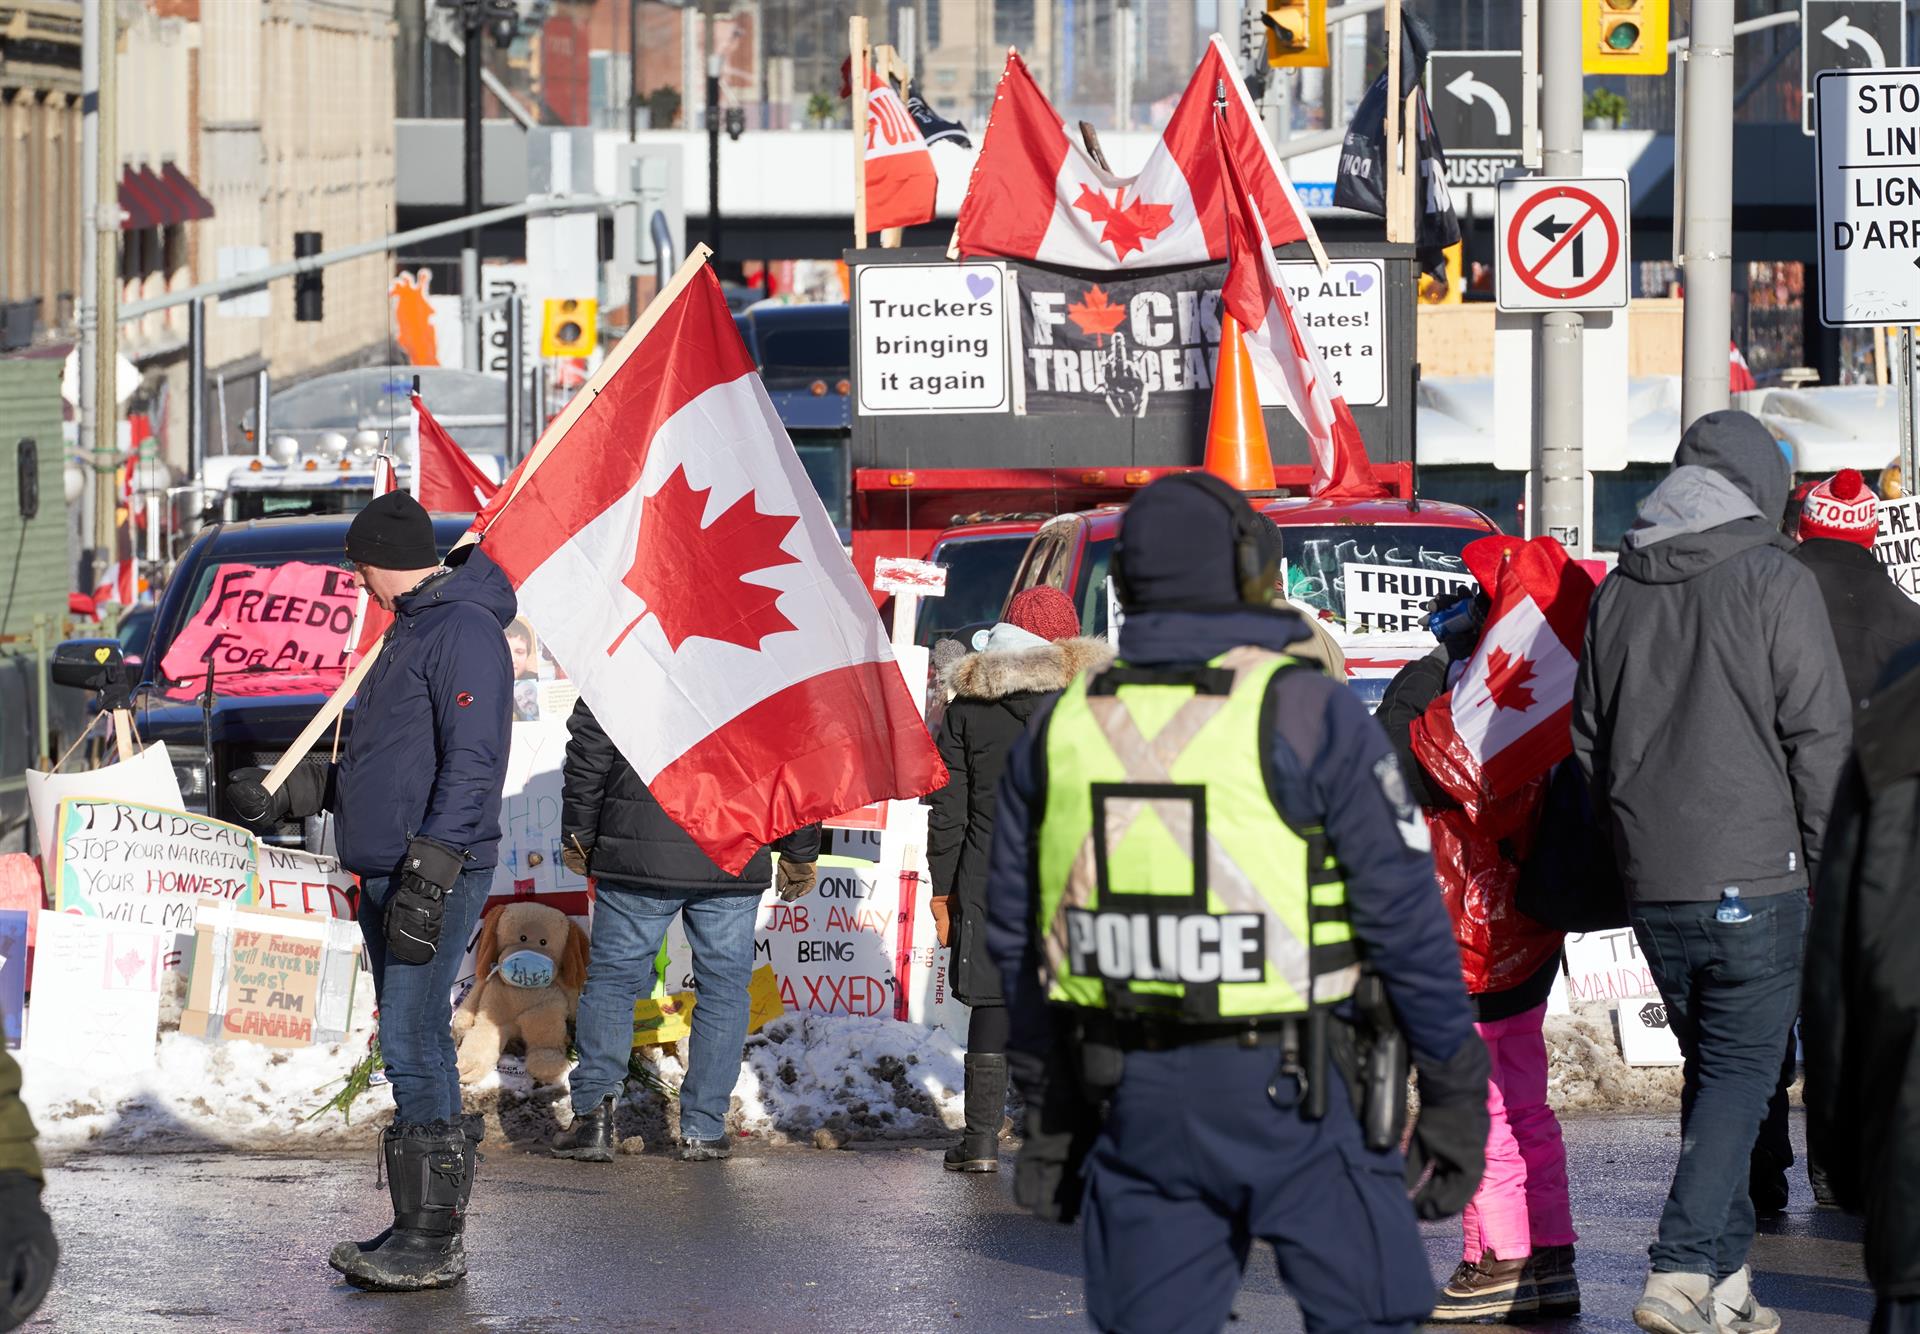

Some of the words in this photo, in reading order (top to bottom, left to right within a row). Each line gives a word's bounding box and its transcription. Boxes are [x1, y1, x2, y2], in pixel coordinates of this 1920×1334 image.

[1866, 126, 1920, 156] LIN
[1318, 282, 1362, 297] ALL
[869, 299, 993, 318] Truckers
[1030, 290, 1224, 347] FCK
[876, 335, 989, 358] bringing
[1360, 344, 1373, 357] a
[881, 372, 899, 391] it
[909, 371, 985, 395] again
[1815, 501, 1876, 524] TOQUE
[65, 838, 118, 862] STOP
[123, 840, 164, 862] YOUR
[269, 852, 304, 870] ME
[83, 868, 134, 896] YOUR
[146, 869, 247, 900] HONNESTY
[819, 877, 877, 900] ONLY
[162, 903, 197, 927] MA
[764, 905, 809, 933] JAB
[825, 905, 893, 937] AWAY
[234, 931, 260, 948] MY
[797, 940, 855, 963] BEING
[1068, 912, 1262, 983] POLICE
[260, 951, 302, 973] NEVER
[304, 959, 320, 976] BE
[935, 966, 946, 1005] FATHER
[237, 987, 258, 1004] I
[266, 991, 304, 1013] AM
[223, 1007, 312, 1042] CANADA
